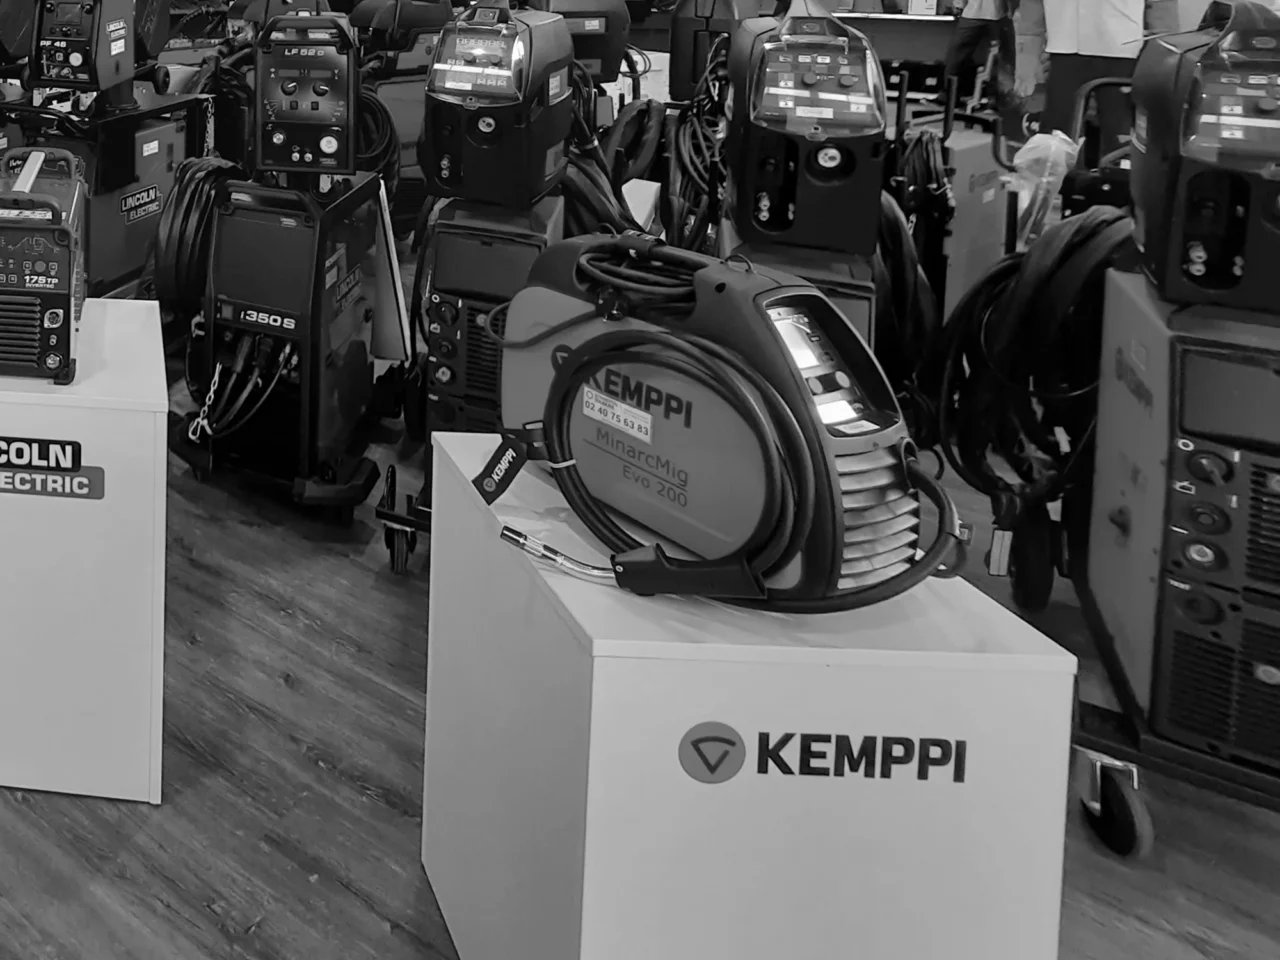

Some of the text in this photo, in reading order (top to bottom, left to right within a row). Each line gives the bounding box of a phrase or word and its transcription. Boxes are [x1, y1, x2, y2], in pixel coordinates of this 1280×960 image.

[122, 187, 156, 211] LINCOLN
[129, 201, 160, 220] ELECTRIC
[584, 400, 596, 411] 02
[597, 407, 609, 417] 40
[610, 411, 622, 423] 75
[623, 418, 635, 430] 63
[636, 424, 649, 436] 83
[491, 447, 517, 483] KEMPPI
[595, 427, 689, 488] MinarcMig
[622, 465, 688, 508] Evo 200
[756, 731, 968, 783] KEMPPI
